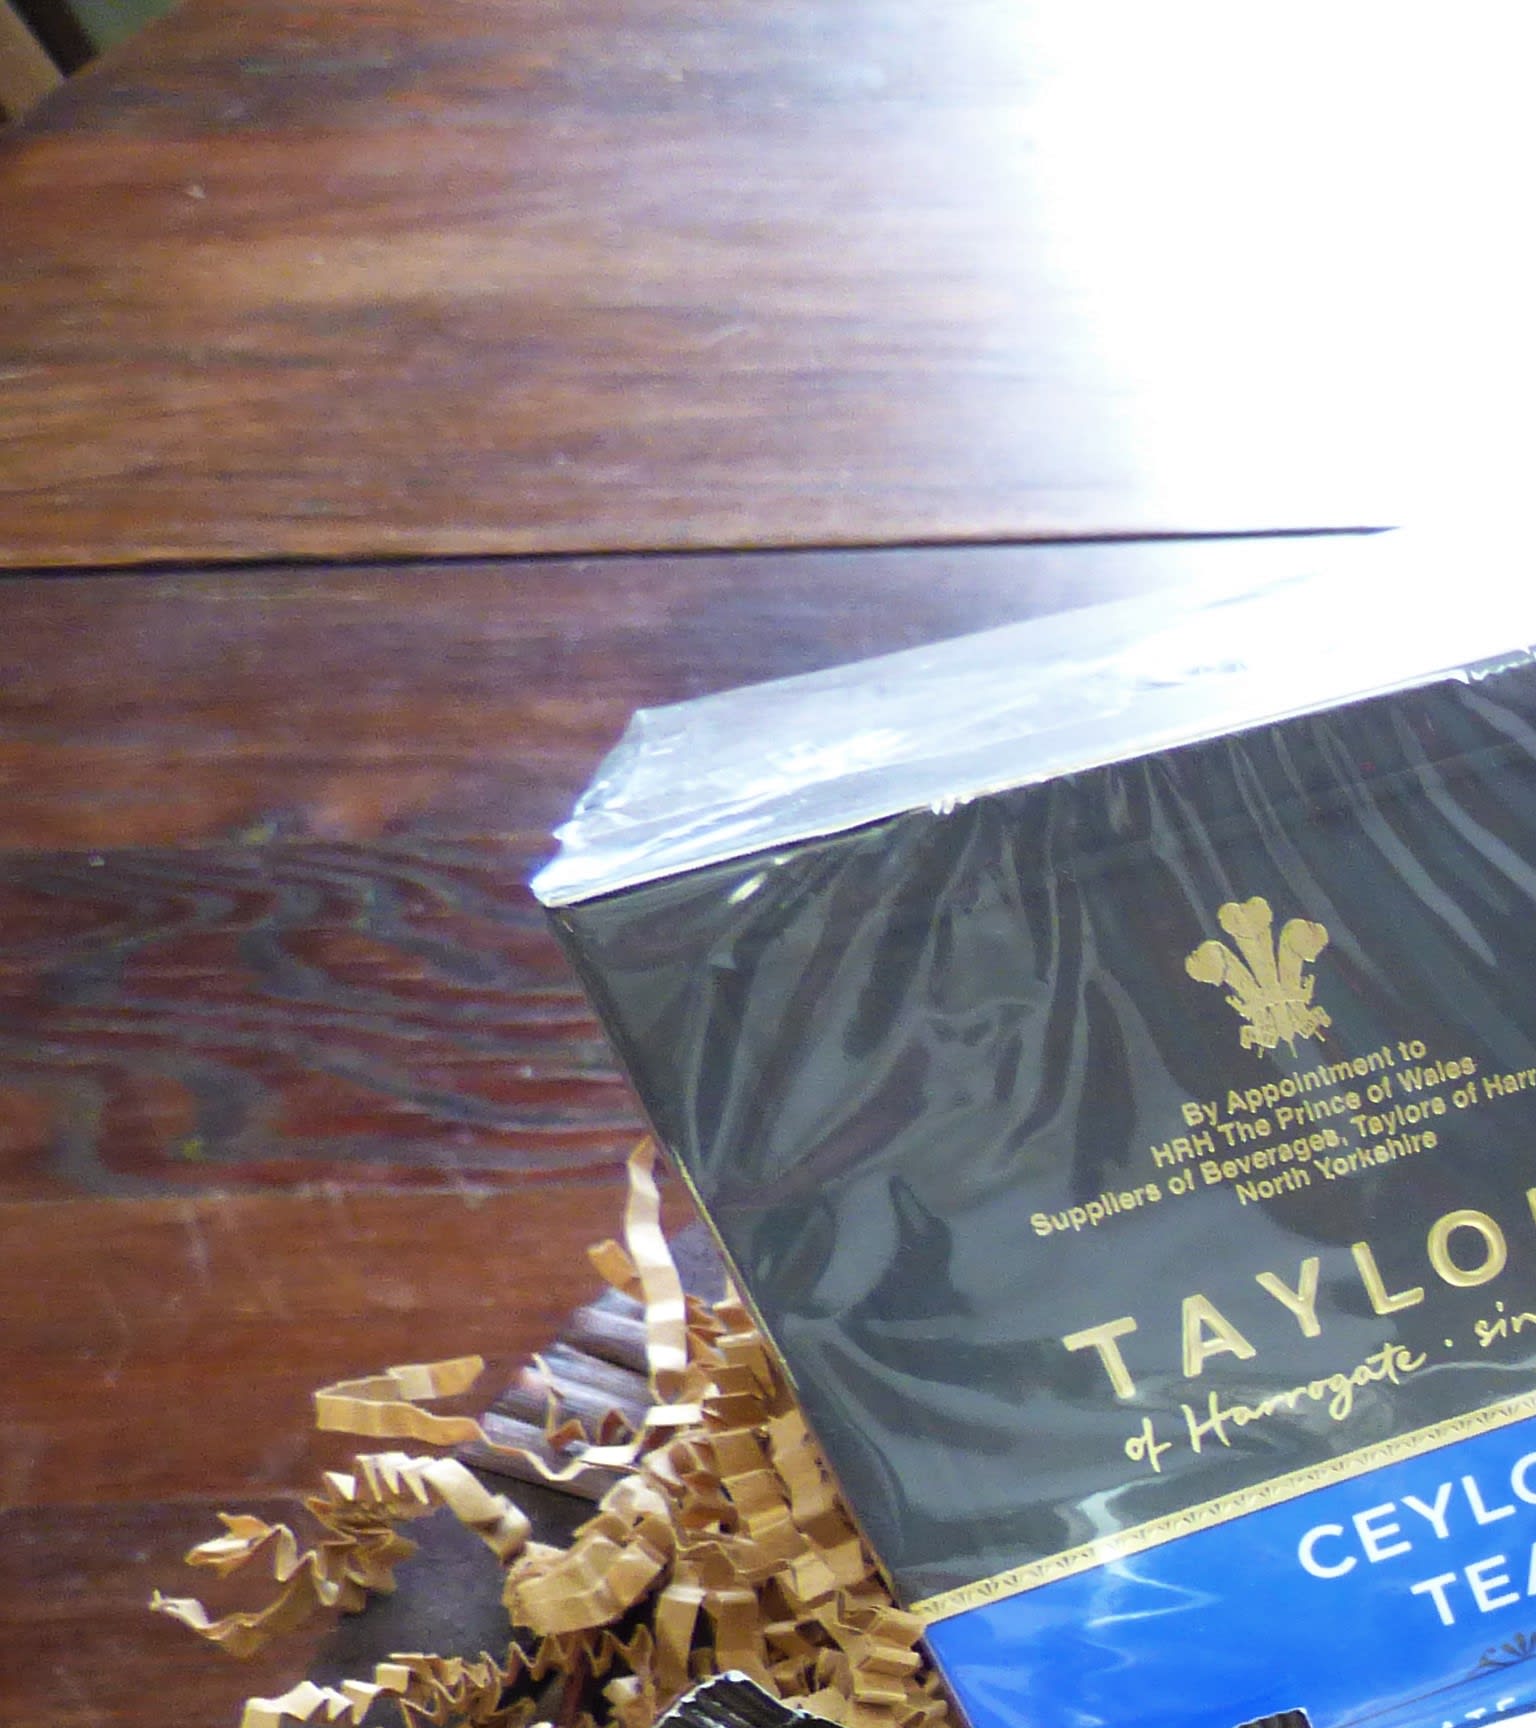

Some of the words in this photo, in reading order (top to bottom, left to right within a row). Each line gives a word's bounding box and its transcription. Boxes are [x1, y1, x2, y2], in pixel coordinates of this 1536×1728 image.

[1150, 1134, 1214, 1170] HRH
[1217, 1118, 1272, 1150] The
[1276, 1092, 1361, 1134] Prince
[1364, 1076, 1394, 1104] of
[1396, 1055, 1477, 1095] Wales
[1181, 1098, 1220, 1130] By
[1225, 1046, 1393, 1119] Appointment
[1397, 1040, 1428, 1064] to
[1030, 1181, 1163, 1238] Suppliers
[1167, 1168, 1197, 1196] of
[1352, 1099, 1450, 1149] Taylors
[1453, 1082, 1482, 1110] of
[1235, 1169, 1312, 1206] North
[1316, 1129, 1438, 1183] Yorkshire
[1125, 1416, 1173, 1474] of
[1180, 1342, 1427, 1454] Harrogate
